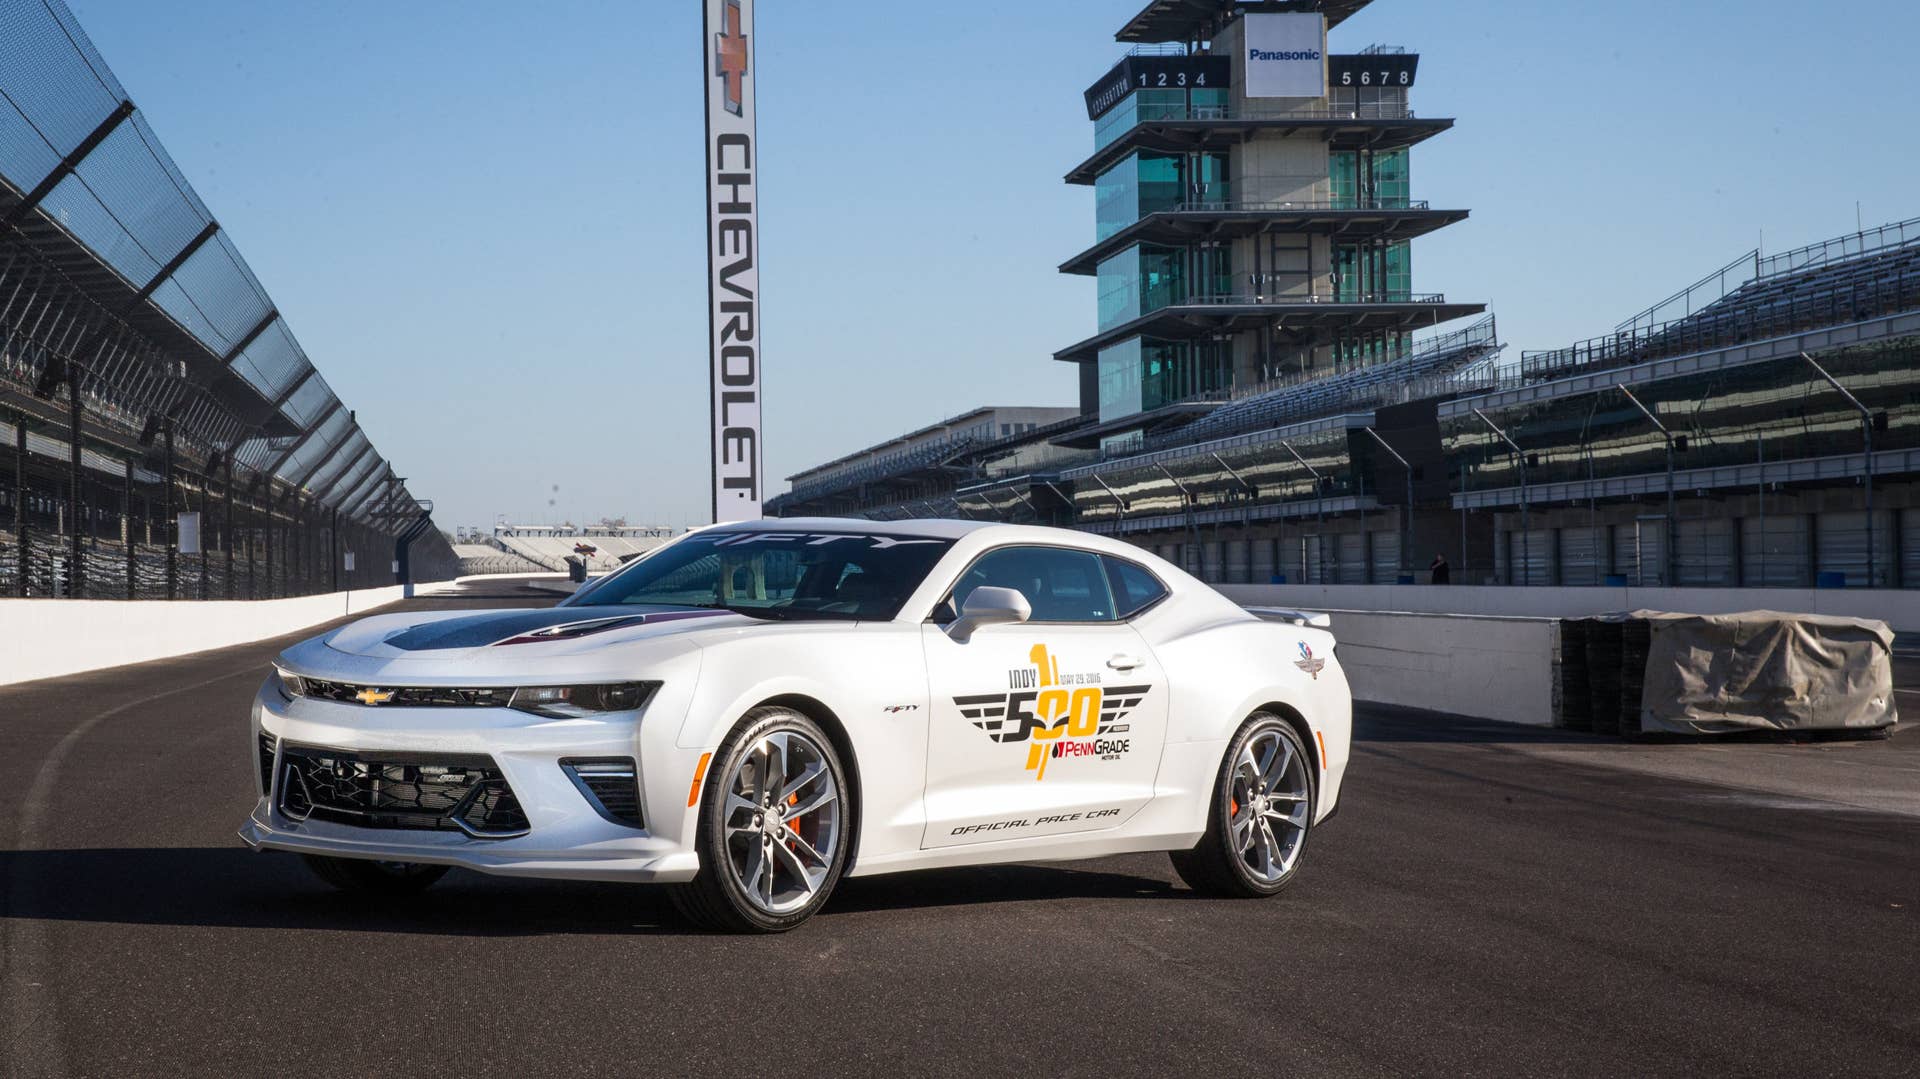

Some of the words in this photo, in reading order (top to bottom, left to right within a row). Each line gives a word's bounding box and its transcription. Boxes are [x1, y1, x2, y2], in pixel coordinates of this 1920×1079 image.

[1250, 48, 1320, 62] Panasonic
[1139, 73, 1147, 86] 1
[1158, 72, 1167, 86] 2
[1177, 72, 1186, 86] 3
[1196, 73, 1206, 86] 4
[1342, 72, 1351, 85] 5
[1361, 72, 1370, 85] 6
[1381, 72, 1390, 85] 7
[1399, 71, 1408, 85] 8
[716, 133, 757, 502] CHEVROLET
[1008, 669, 1036, 689] INDY
[1002, 687, 1102, 743] 500
[950, 819, 1031, 836] OFFICIAL
[1034, 813, 1082, 826] PACE
[1085, 809, 1121, 819] CAR
